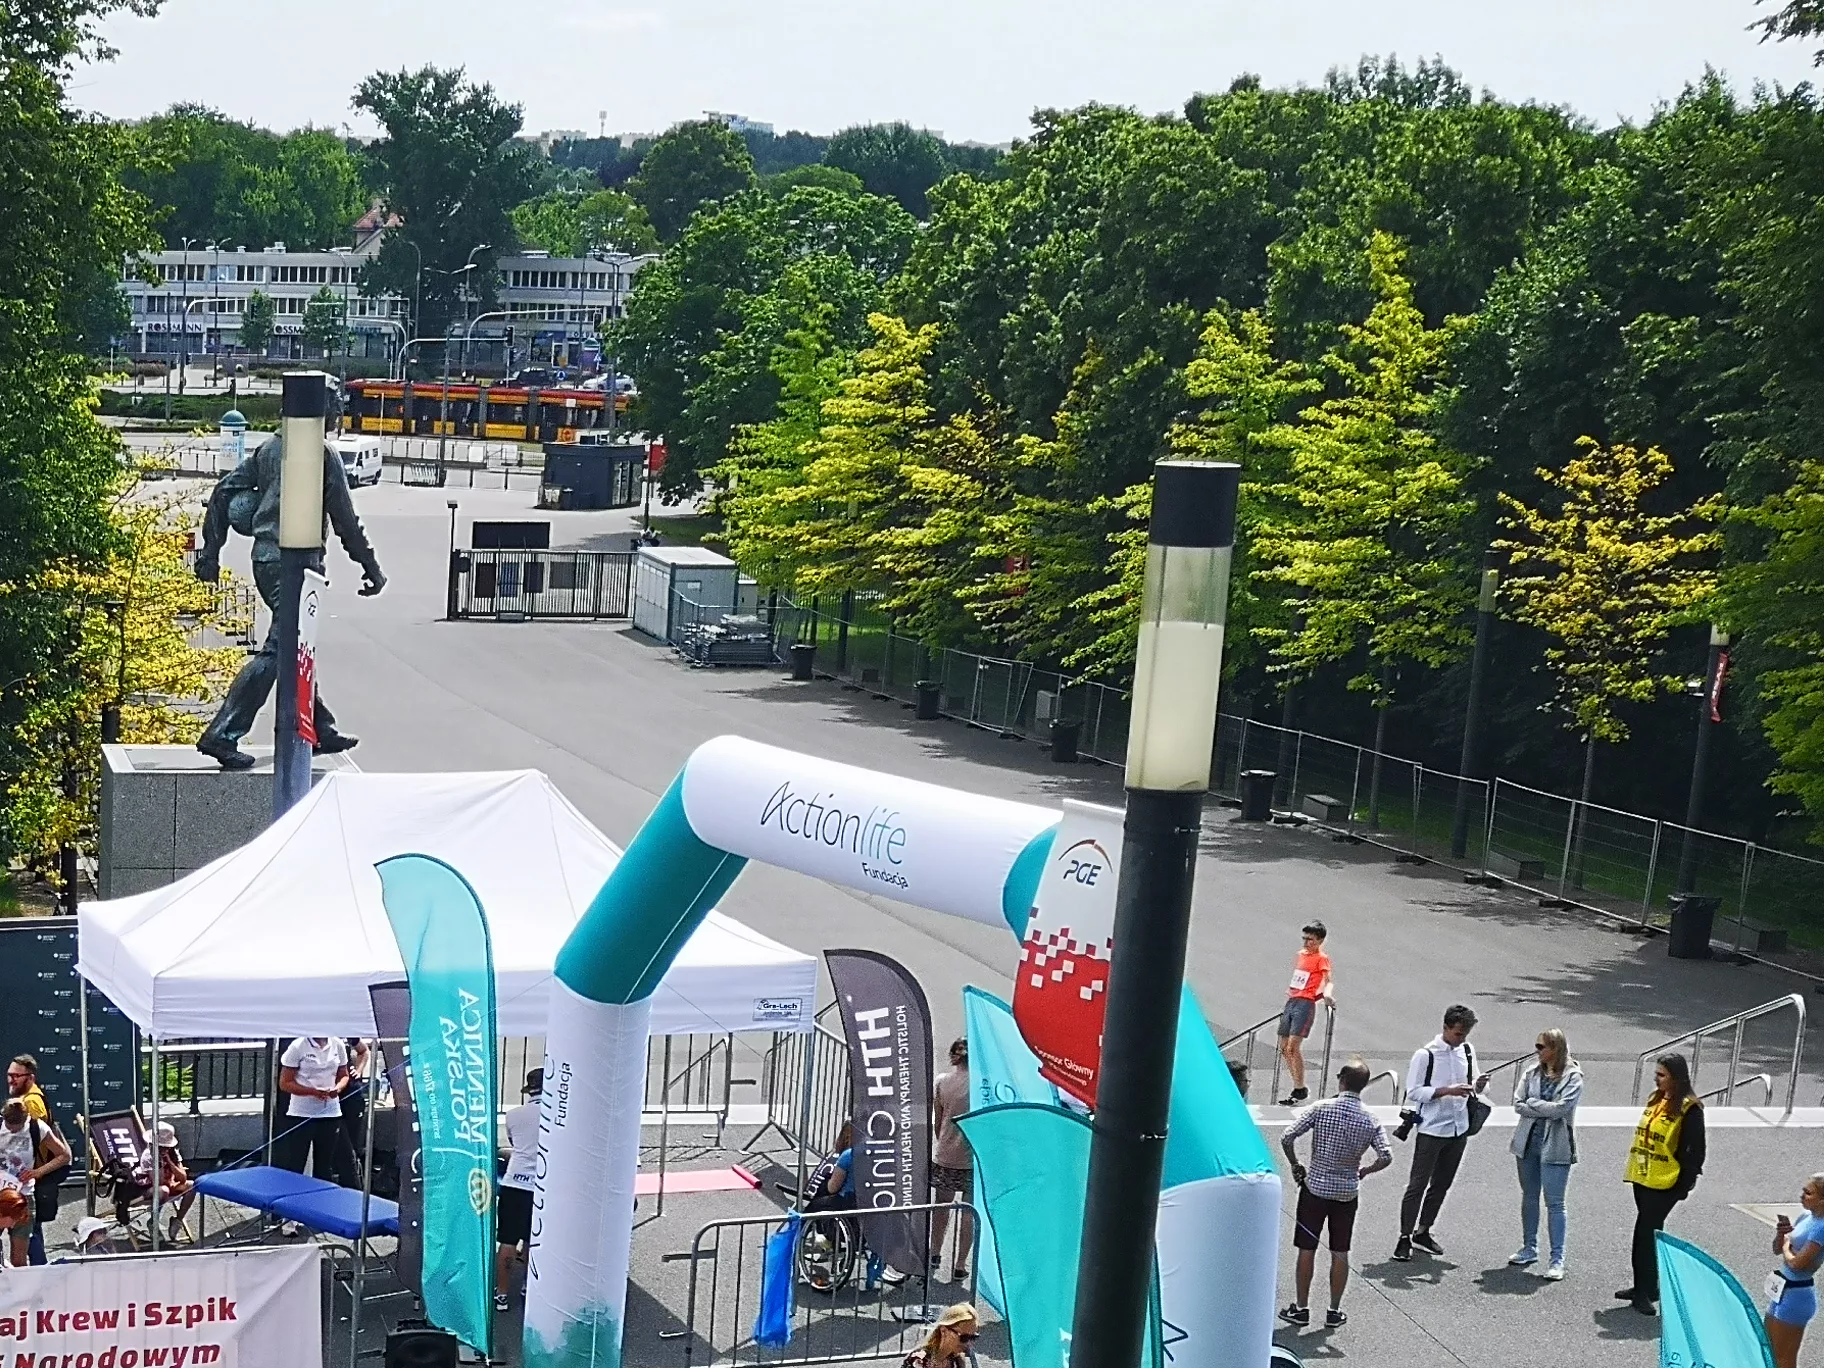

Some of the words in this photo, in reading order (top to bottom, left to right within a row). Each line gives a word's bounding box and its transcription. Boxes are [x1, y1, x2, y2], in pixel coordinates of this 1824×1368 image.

[760, 781, 907, 865] Actionlife
[862, 862, 909, 889] Fundacja
[1063, 859, 1102, 887] PGE
[554, 1063, 573, 1128] Fundacja
[36, 1308, 120, 1334] Krew
[127, 1303, 136, 1328] i
[143, 1296, 237, 1329] Szpik
